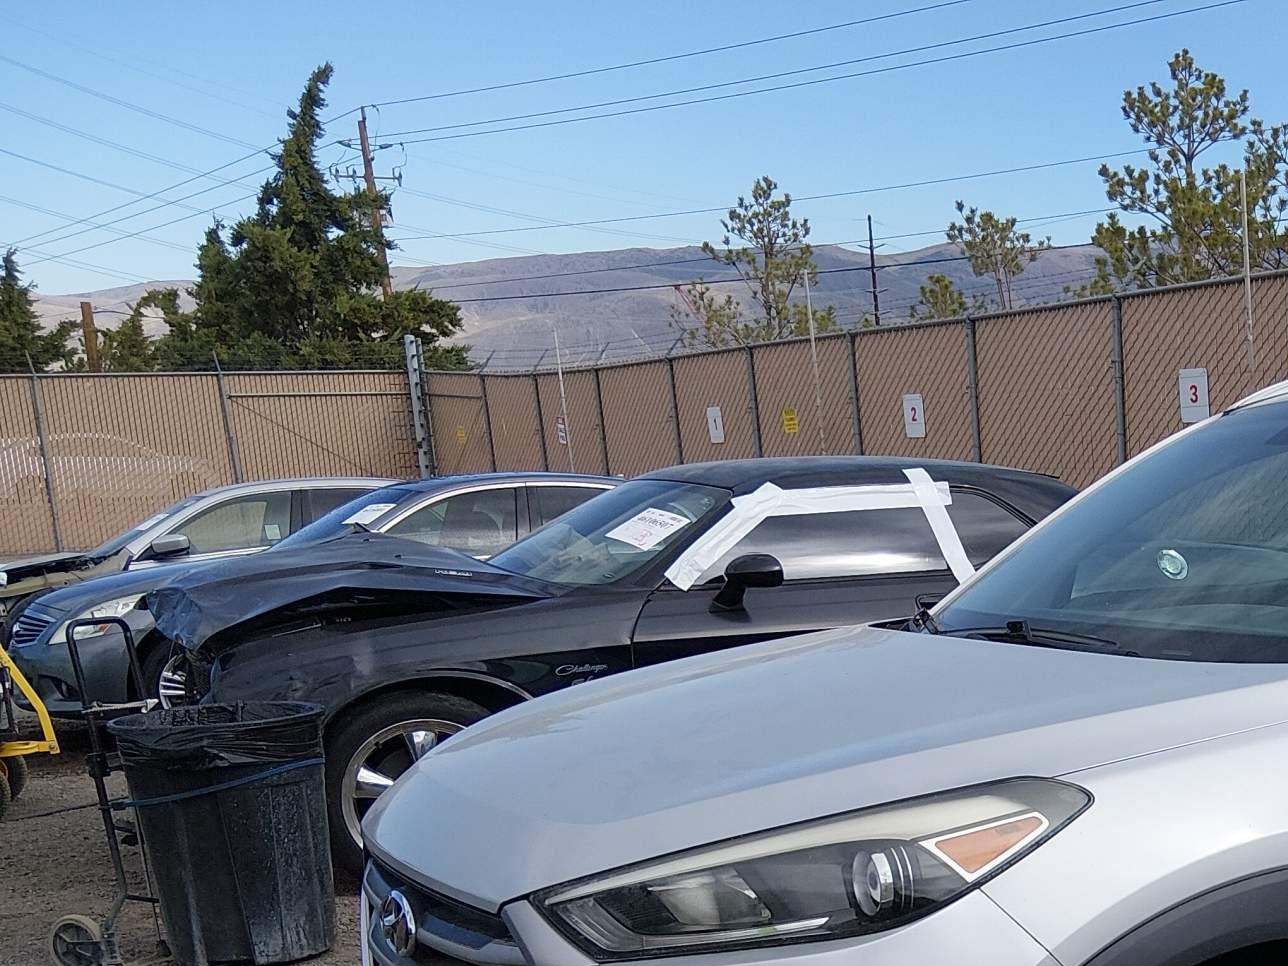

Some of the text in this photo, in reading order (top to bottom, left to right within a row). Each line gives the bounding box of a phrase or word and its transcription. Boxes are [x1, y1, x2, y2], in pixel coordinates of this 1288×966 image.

[1189, 384, 1199, 404] 3
[910, 406, 919, 422] 2
[554, 663, 609, 676] Challenger
